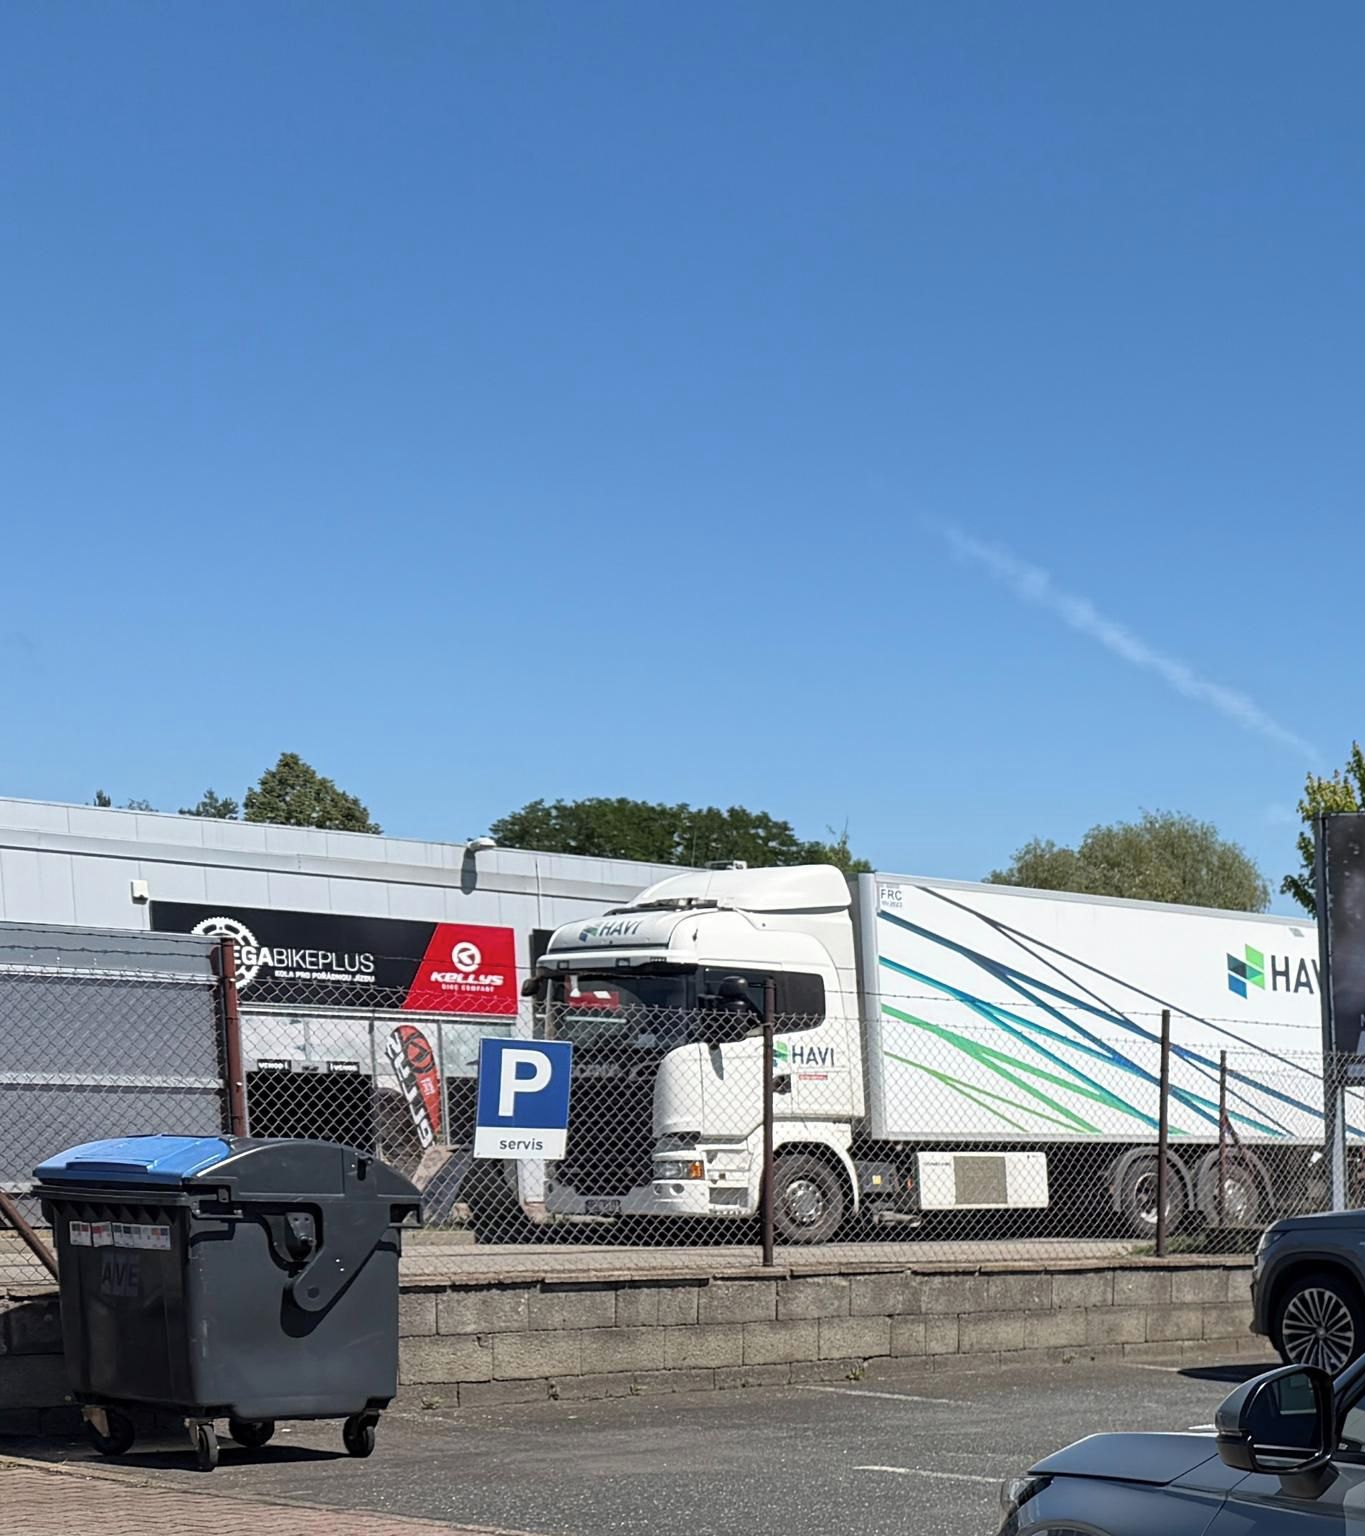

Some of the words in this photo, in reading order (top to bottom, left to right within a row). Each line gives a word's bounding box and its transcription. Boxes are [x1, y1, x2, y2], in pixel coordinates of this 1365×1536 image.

[880, 888, 902, 901] FRC
[599, 920, 642, 937] HAVI
[234, 945, 375, 973] EGABIKEPLUS
[792, 1045, 835, 1068] HAVI
[498, 1048, 552, 1117] P
[499, 1138, 543, 1151] servis
[102, 1262, 139, 1288] AVE
